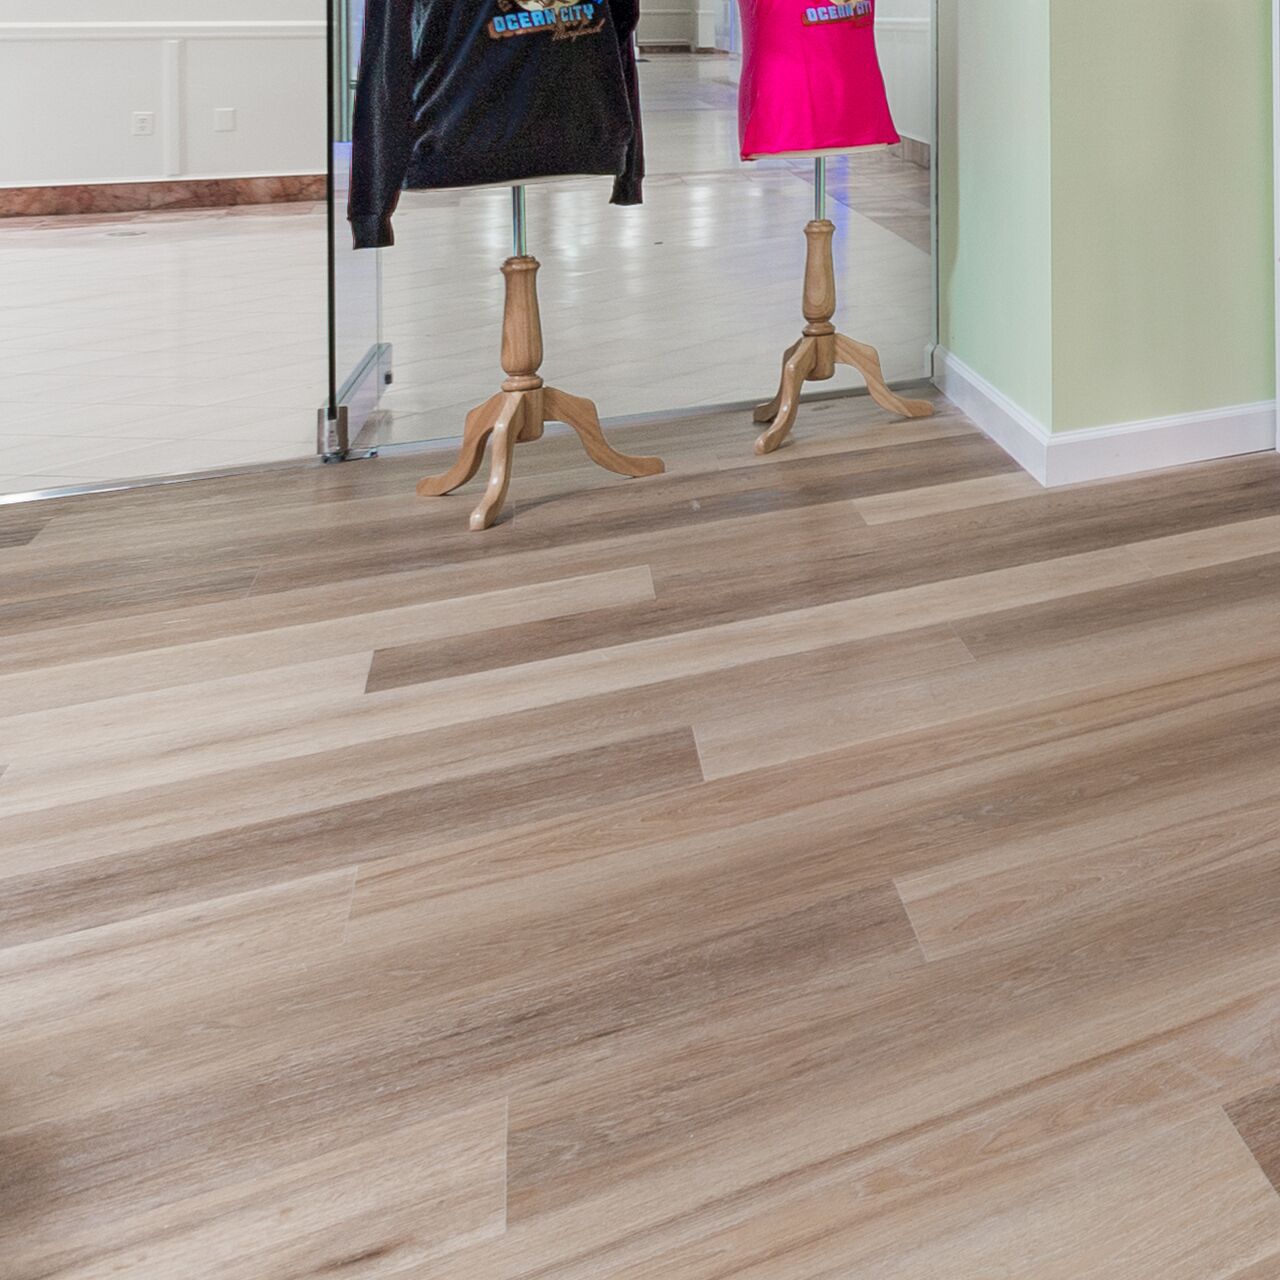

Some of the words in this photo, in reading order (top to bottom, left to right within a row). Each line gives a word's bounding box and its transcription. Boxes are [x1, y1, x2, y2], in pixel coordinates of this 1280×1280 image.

[492, 7, 557, 33] OCEAN
[559, 3, 595, 22] CITY
[805, 3, 854, 23] OCEAN
